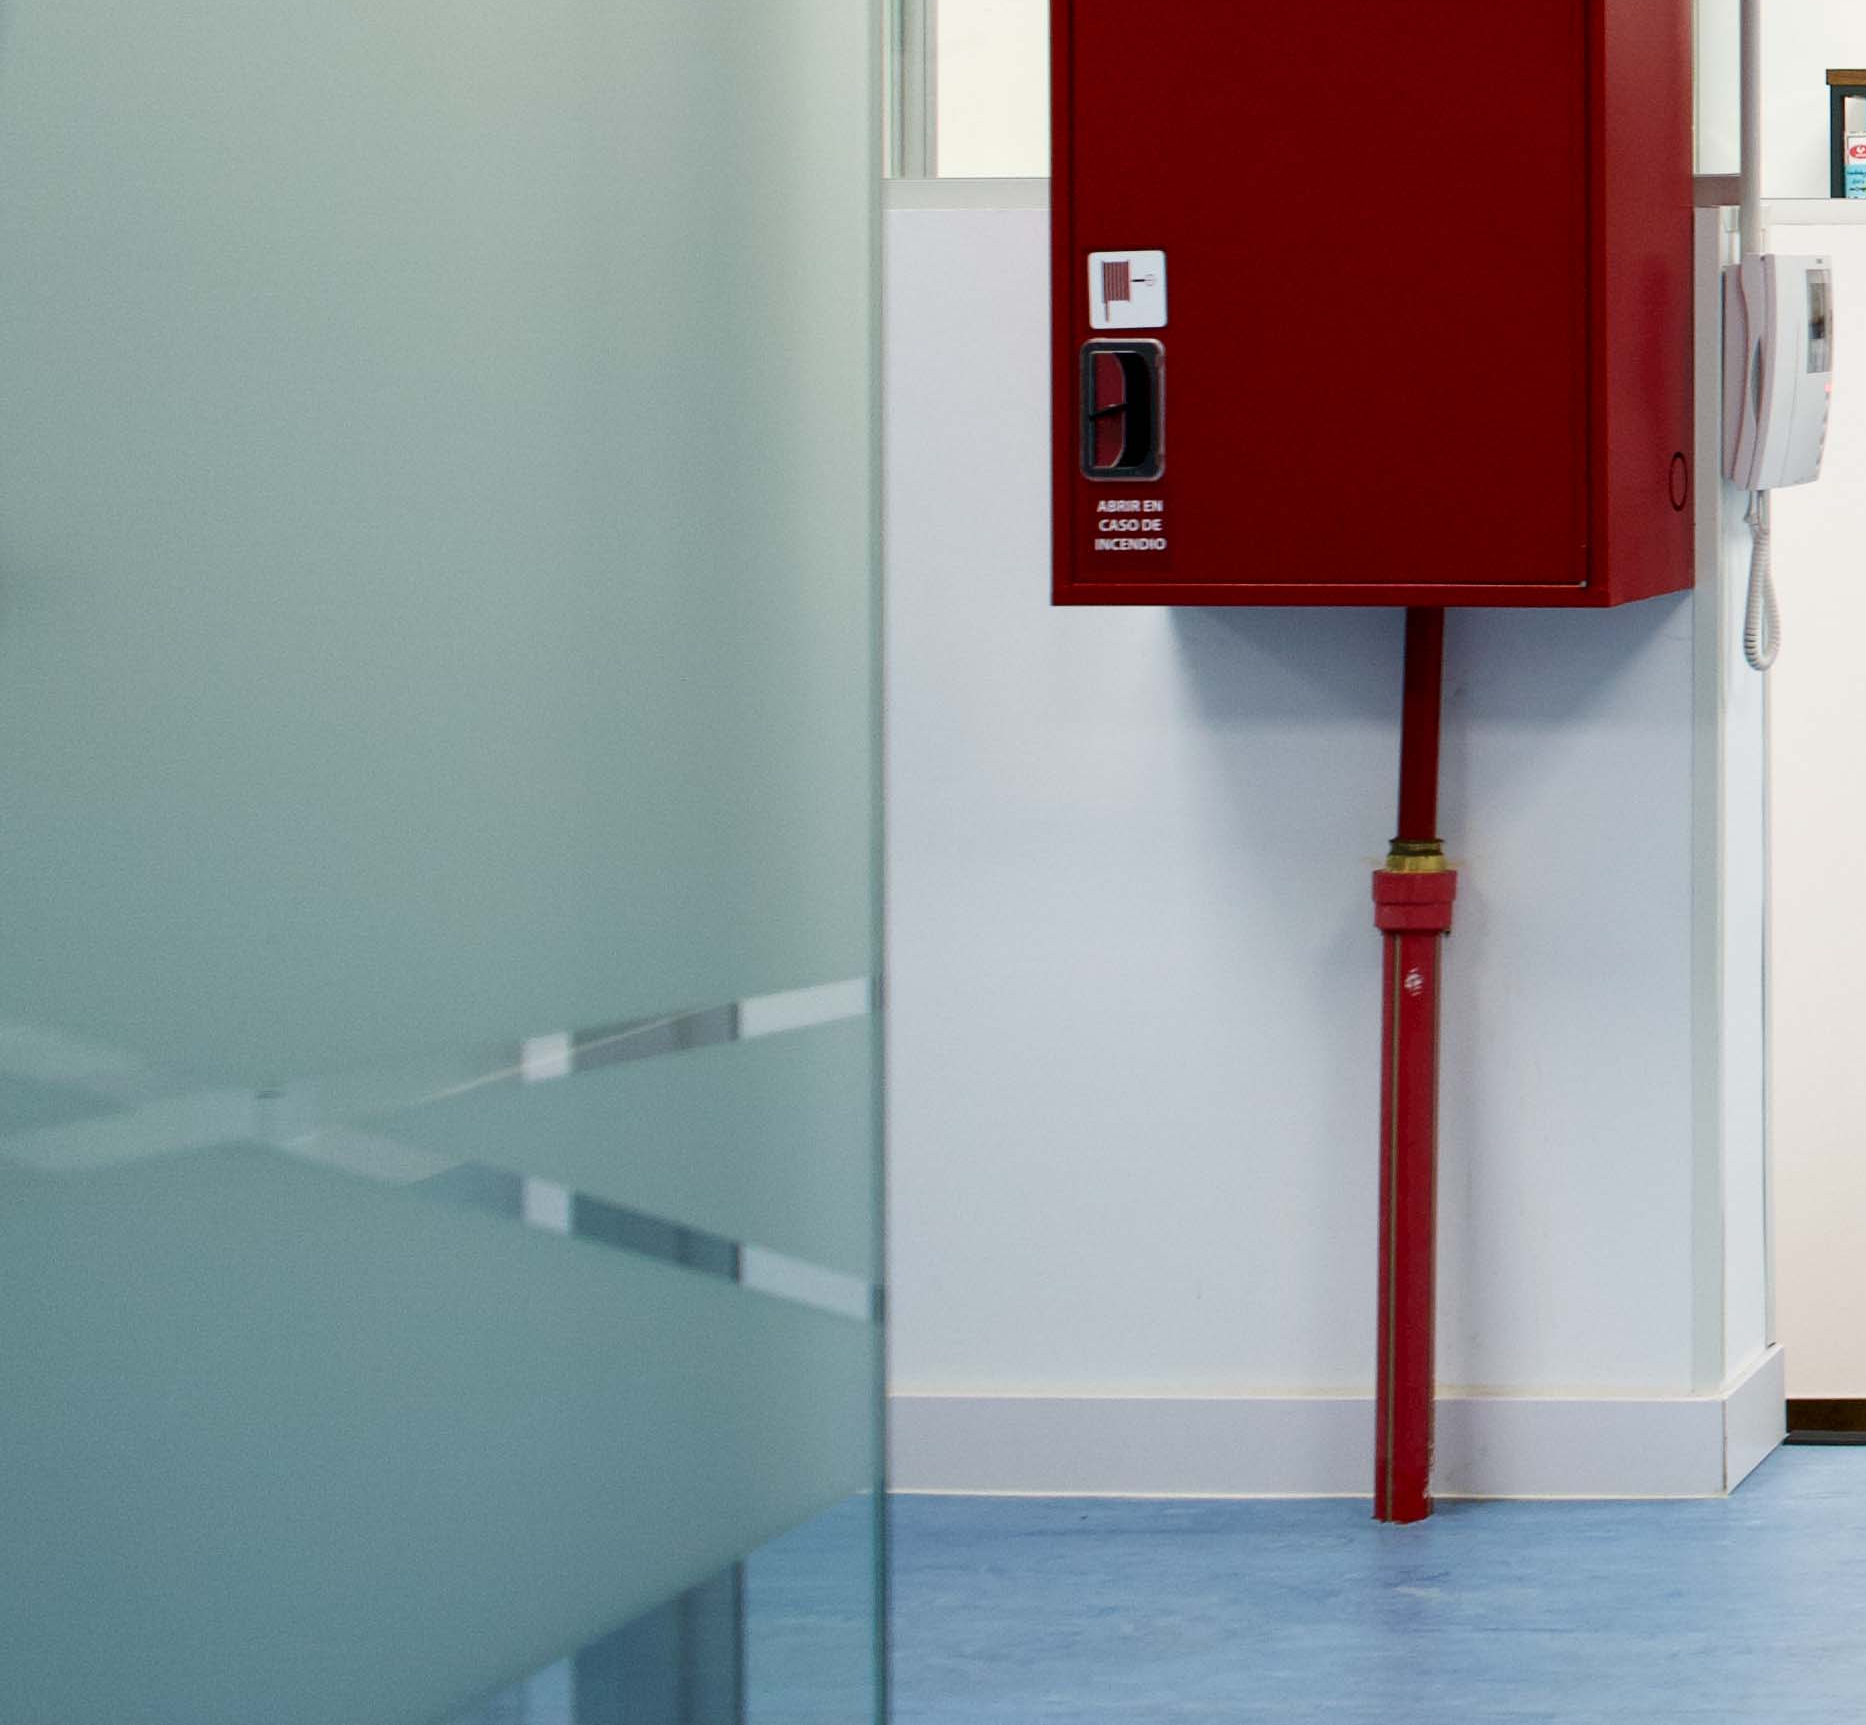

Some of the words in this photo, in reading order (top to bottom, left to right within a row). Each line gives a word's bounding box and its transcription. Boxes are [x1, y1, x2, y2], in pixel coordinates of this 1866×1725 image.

[1096, 499, 1141, 513] ABRIR
[1143, 499, 1164, 513] EN
[1098, 518, 1140, 532] CASO
[1141, 518, 1164, 532] DE
[1094, 537, 1167, 551] INCENDIO
